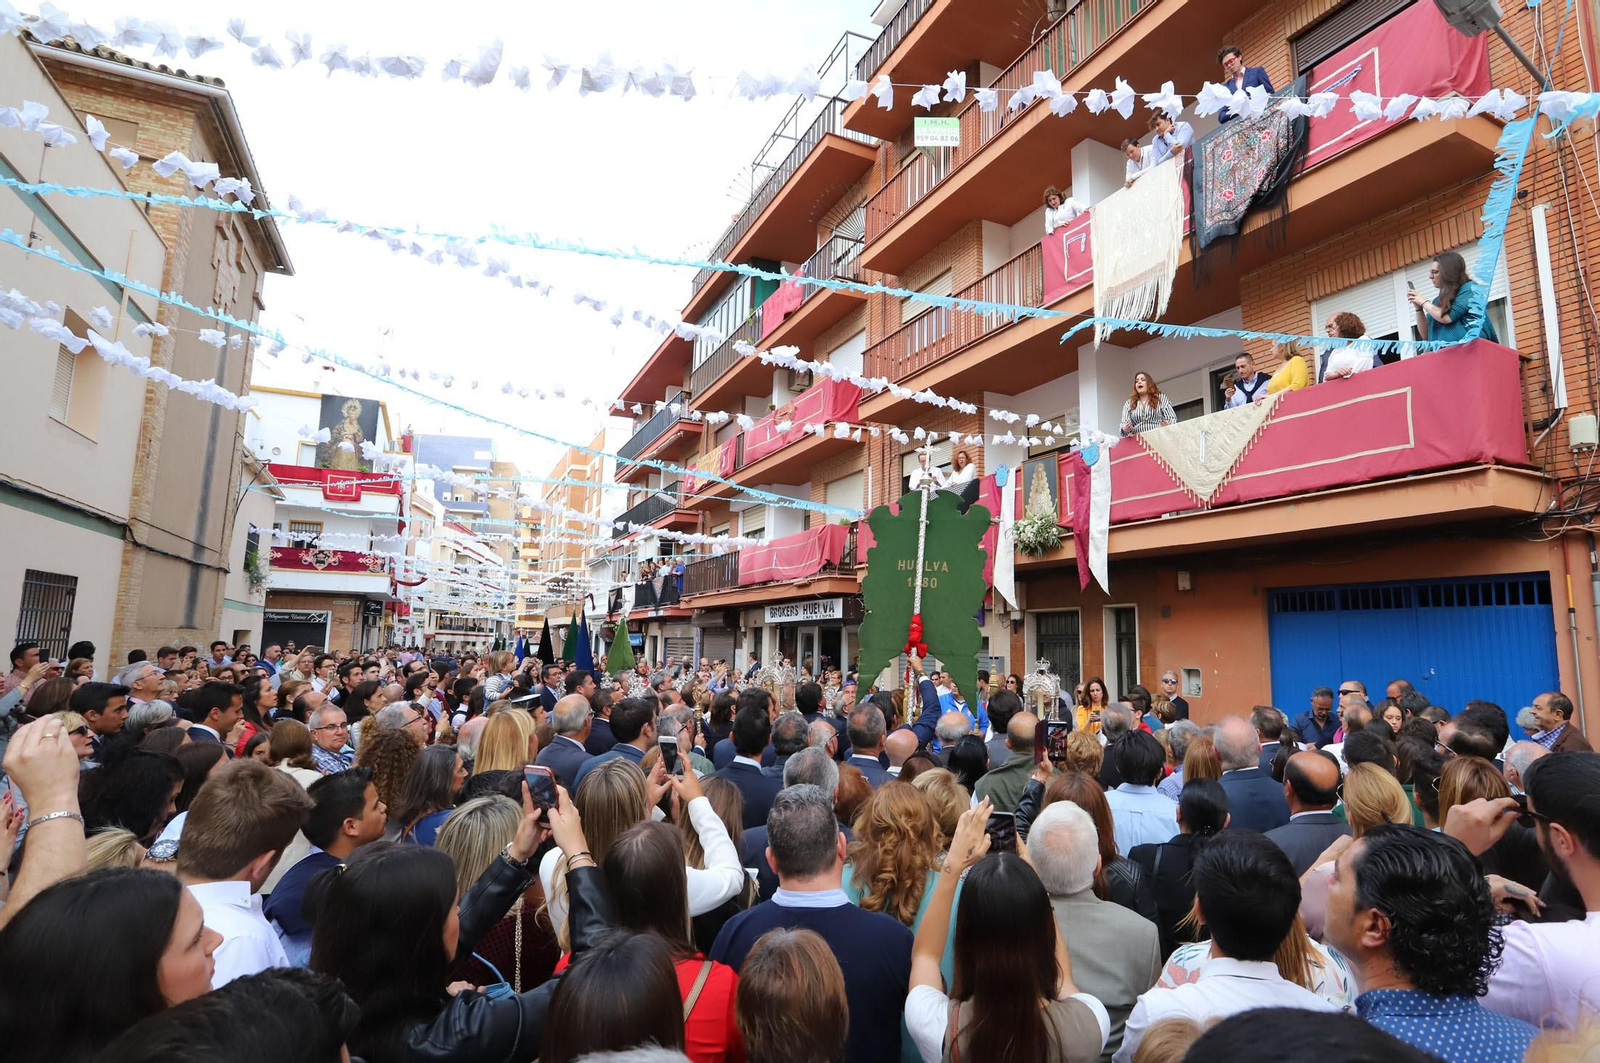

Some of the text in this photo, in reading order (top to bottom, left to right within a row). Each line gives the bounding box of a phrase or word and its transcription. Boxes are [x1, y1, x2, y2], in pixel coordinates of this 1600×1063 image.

[898, 560, 948, 572] HULVA
[907, 577, 937, 588] 180
[770, 605, 798, 618] BROKERS
